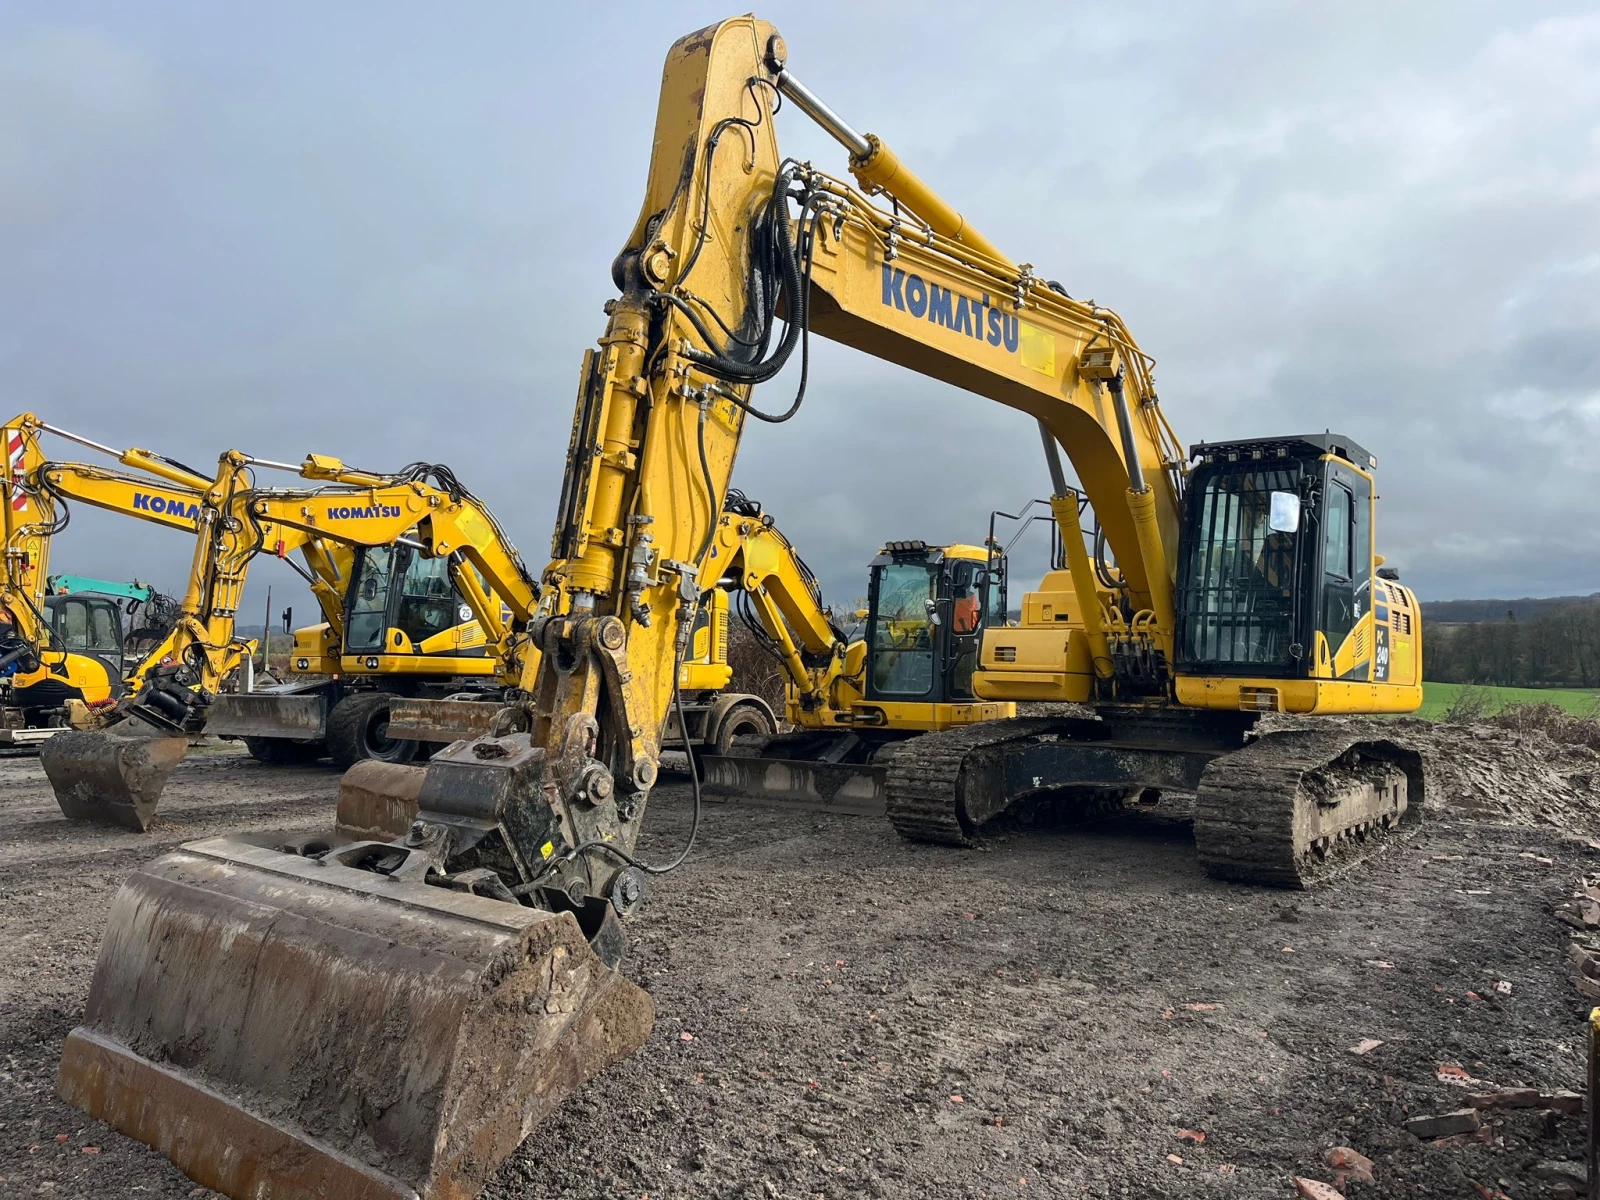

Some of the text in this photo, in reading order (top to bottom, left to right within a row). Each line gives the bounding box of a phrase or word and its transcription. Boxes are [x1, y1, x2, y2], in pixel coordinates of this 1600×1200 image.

[882, 261, 1019, 353] KOMATSU
[133, 492, 201, 518] KOMA
[327, 503, 401, 519] KOMATSU
[462, 608, 470, 618] 25
[1376, 646, 1389, 665] 240
